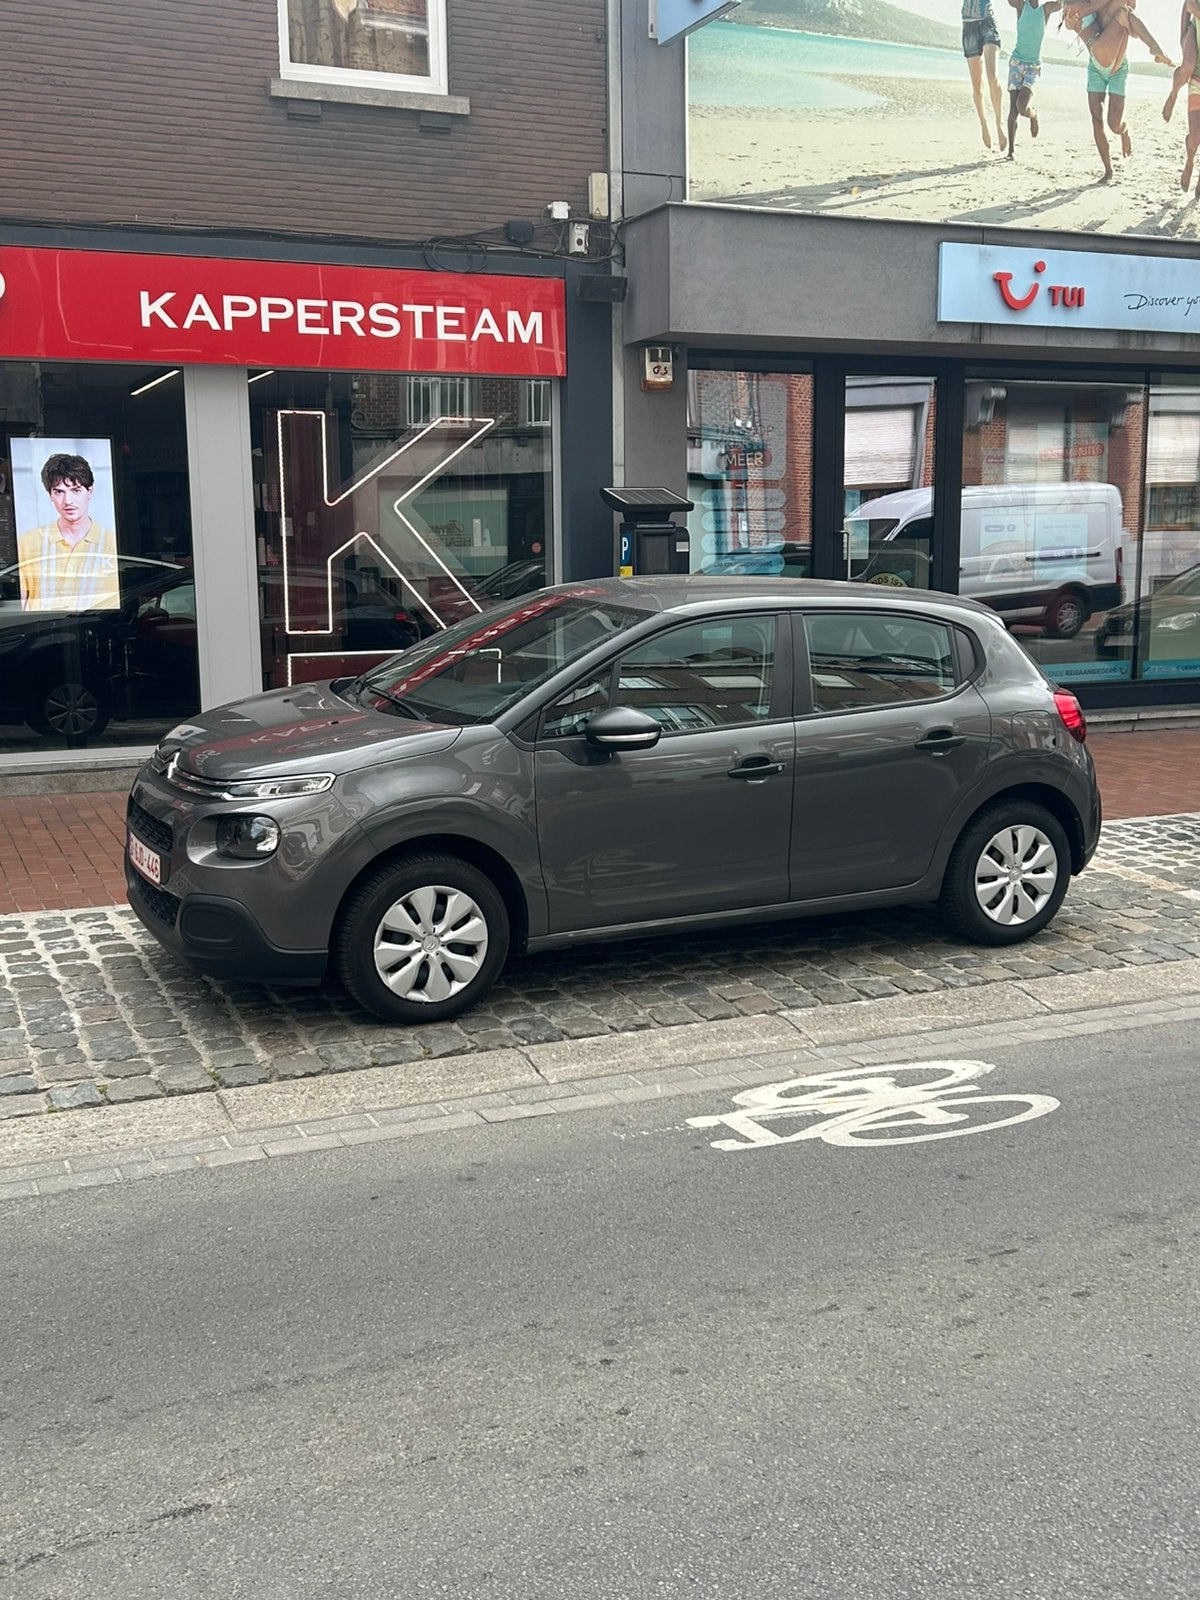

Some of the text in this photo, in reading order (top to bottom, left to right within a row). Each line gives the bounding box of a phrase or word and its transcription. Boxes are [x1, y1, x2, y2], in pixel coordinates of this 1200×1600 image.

[1048, 285, 1085, 308] TUI
[1124, 293, 1184, 310] Discover
[139, 289, 543, 345] KAPPERSTEAM
[724, 451, 764, 467] MEER
[621, 537, 629, 560] P
